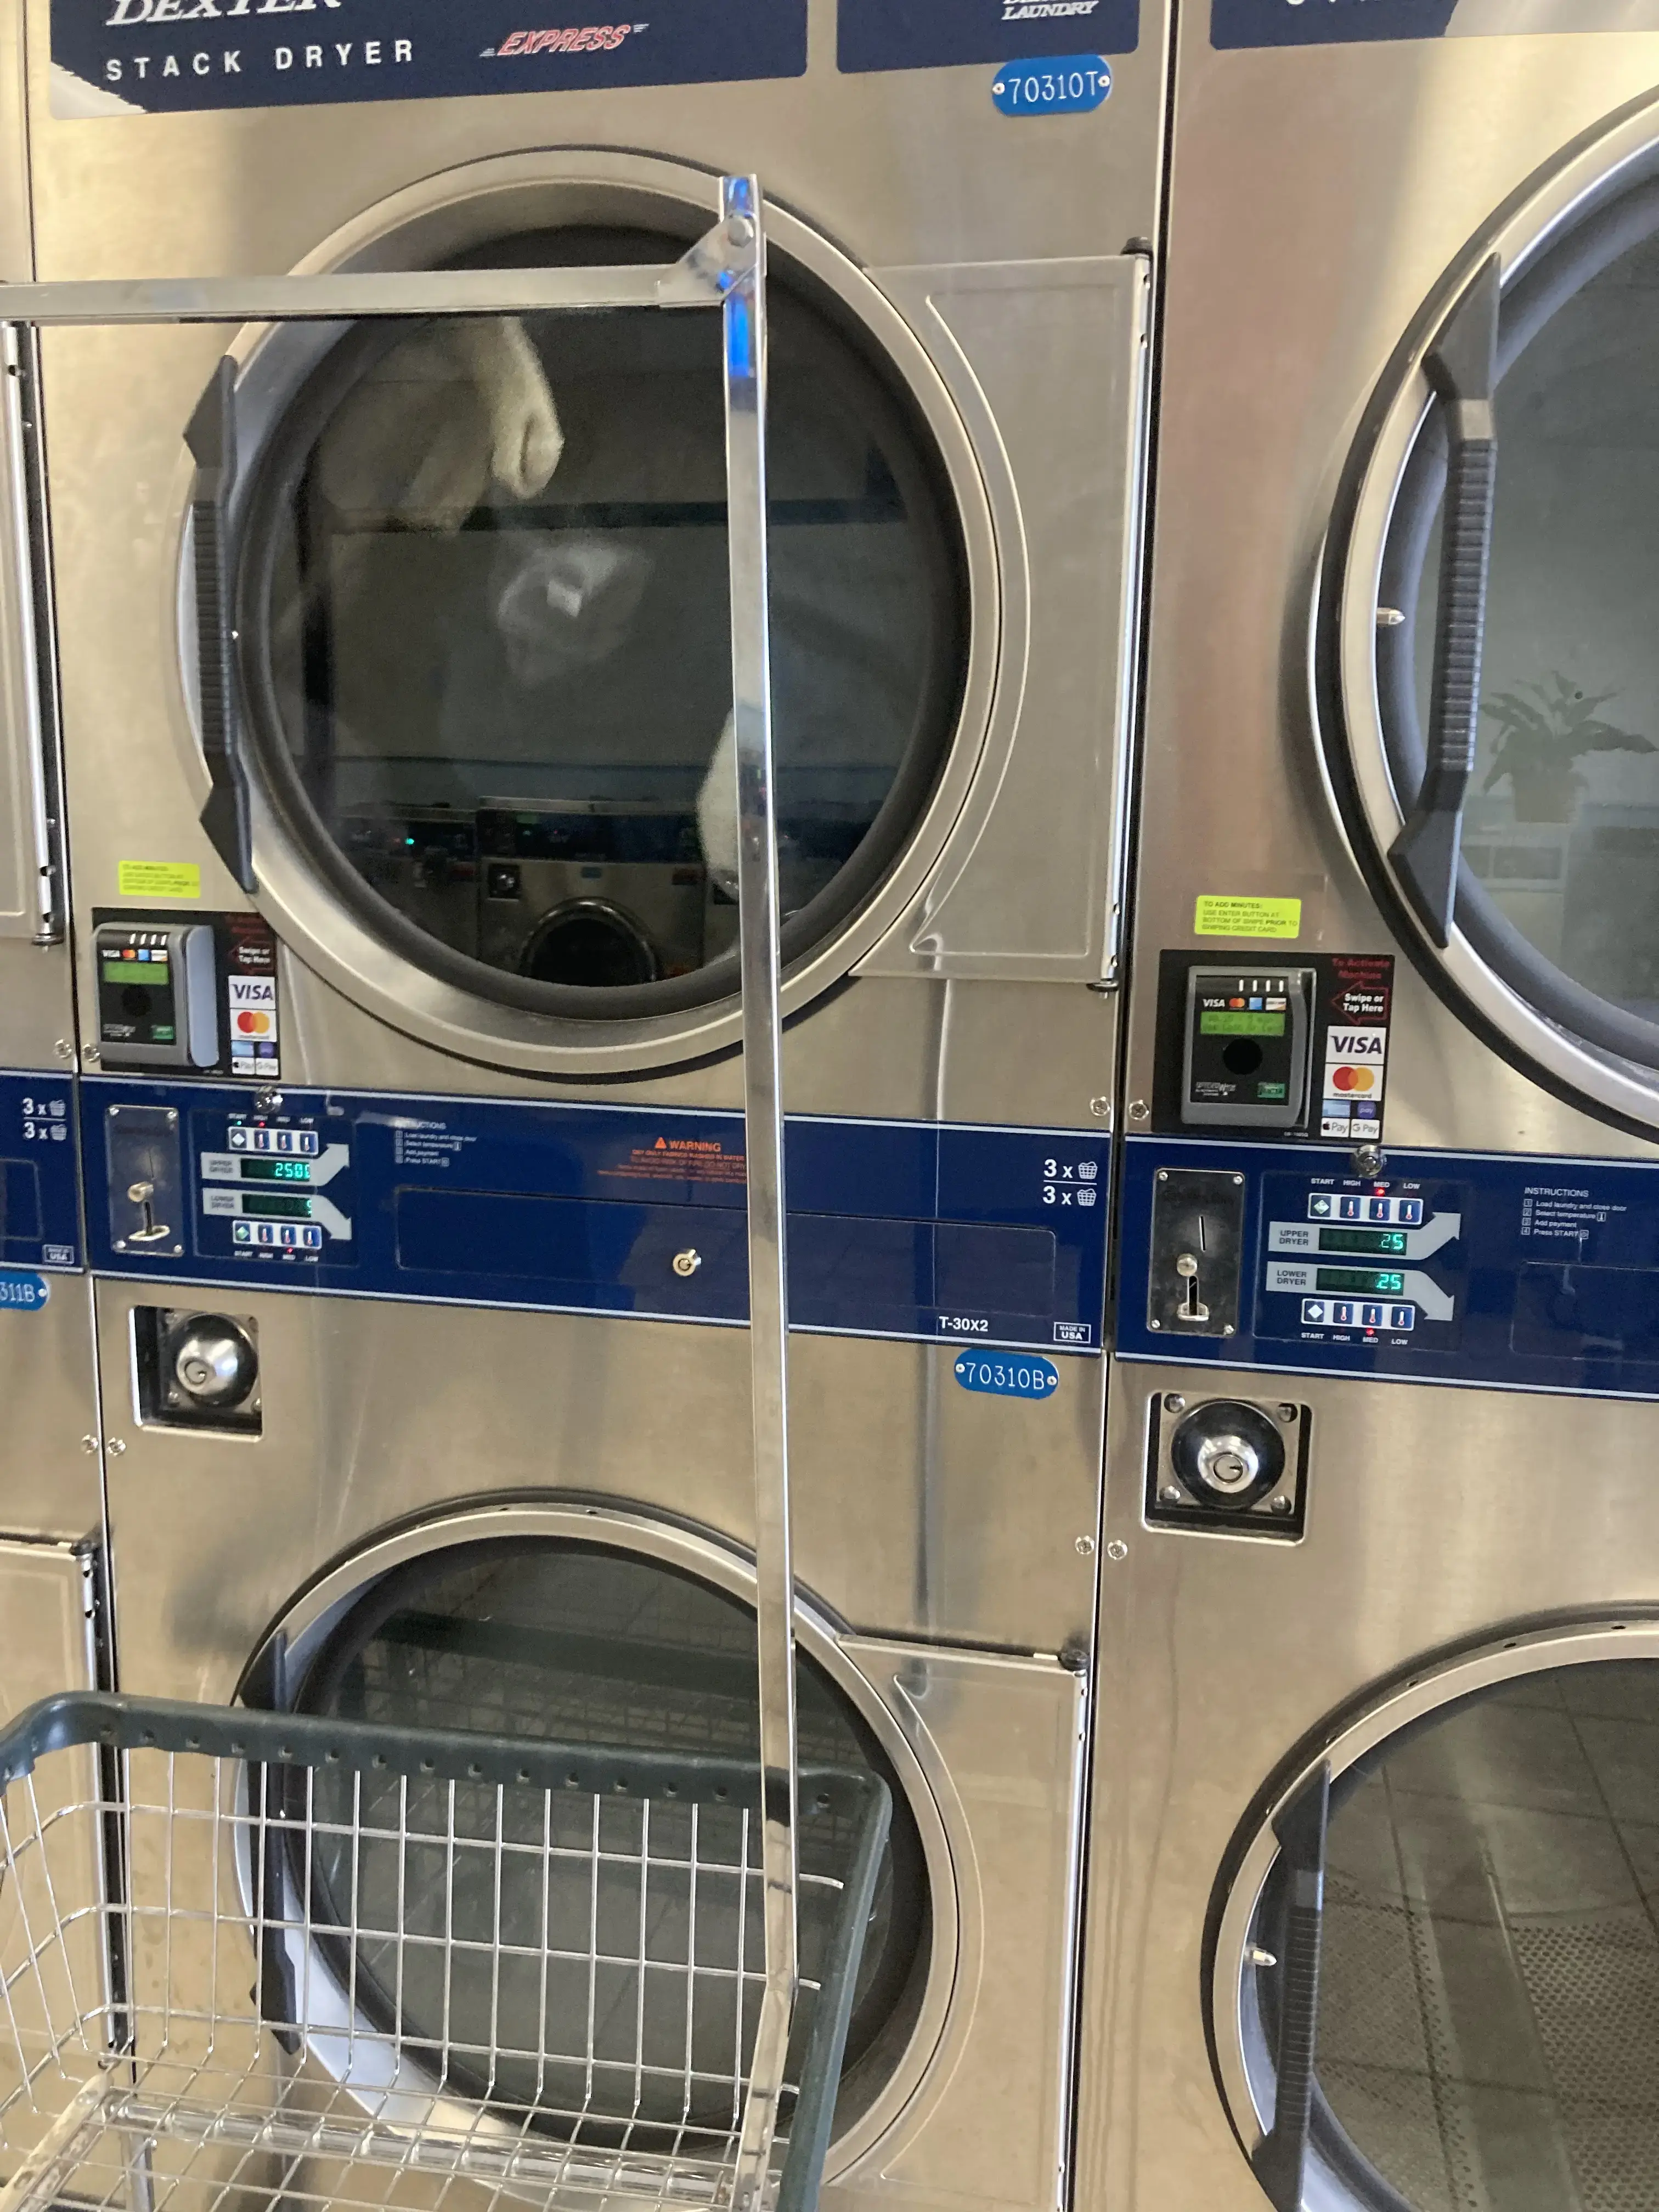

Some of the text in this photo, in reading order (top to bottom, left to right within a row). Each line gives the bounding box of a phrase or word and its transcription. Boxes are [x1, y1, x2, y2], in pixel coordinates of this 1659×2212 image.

[1001, 1, 1099, 20] LAUNDRY
[496, 24, 631, 55] EXPRESS
[106, 40, 413, 81] STACK DRYER
[1009, 71, 1099, 104] 70310T
[230, 984, 274, 1000] VISA
[1345, 993, 1372, 1003] Swipe
[1203, 998, 1225, 1008] VISA
[1343, 1003, 1384, 1013] Tap Here
[1330, 1036, 1382, 1054] VISA
[22, 1098, 33, 1115] 3
[24, 1122, 35, 1139] 3
[1332, 1122, 1348, 1133] Pay
[1363, 1124, 1379, 1135] Pay
[669, 1140, 721, 1152] WARNING
[1045, 1159, 1073, 1178] 3 x
[1043, 1186, 1071, 1205] 3 x
[1525, 1187, 1589, 1197] INSTRUCTIONS
[1381, 1233, 1403, 1249] 25
[1378, 1274, 1402, 1289] 25
[939, 1316, 988, 1332] T-30X2
[1062, 1331, 1082, 1340] USA
[966, 1363, 1044, 1390] 70310B
